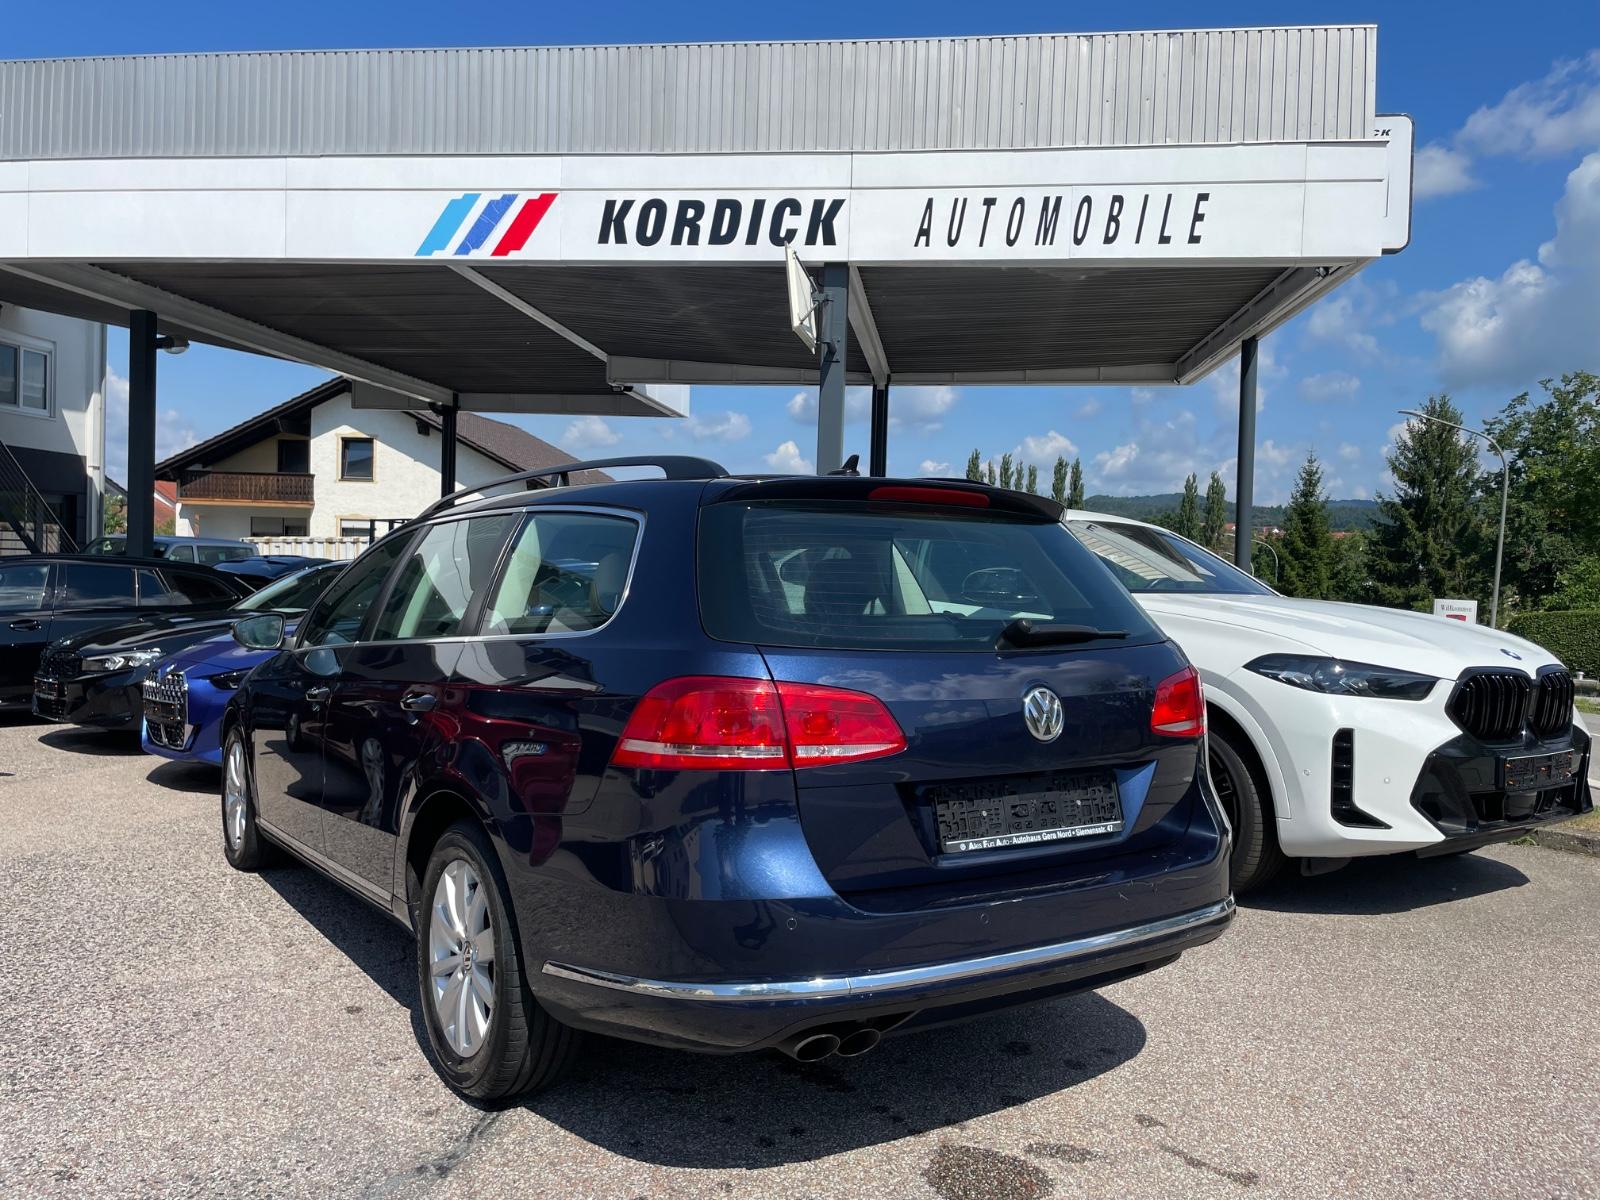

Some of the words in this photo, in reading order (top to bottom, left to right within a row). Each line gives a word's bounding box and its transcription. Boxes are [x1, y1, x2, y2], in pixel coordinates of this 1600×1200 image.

[597, 197, 847, 247] KORDICK
[914, 192, 1210, 248] AUTOMOBILE
[1057, 830, 1072, 839] Nord
[1106, 824, 1114, 832] 47
